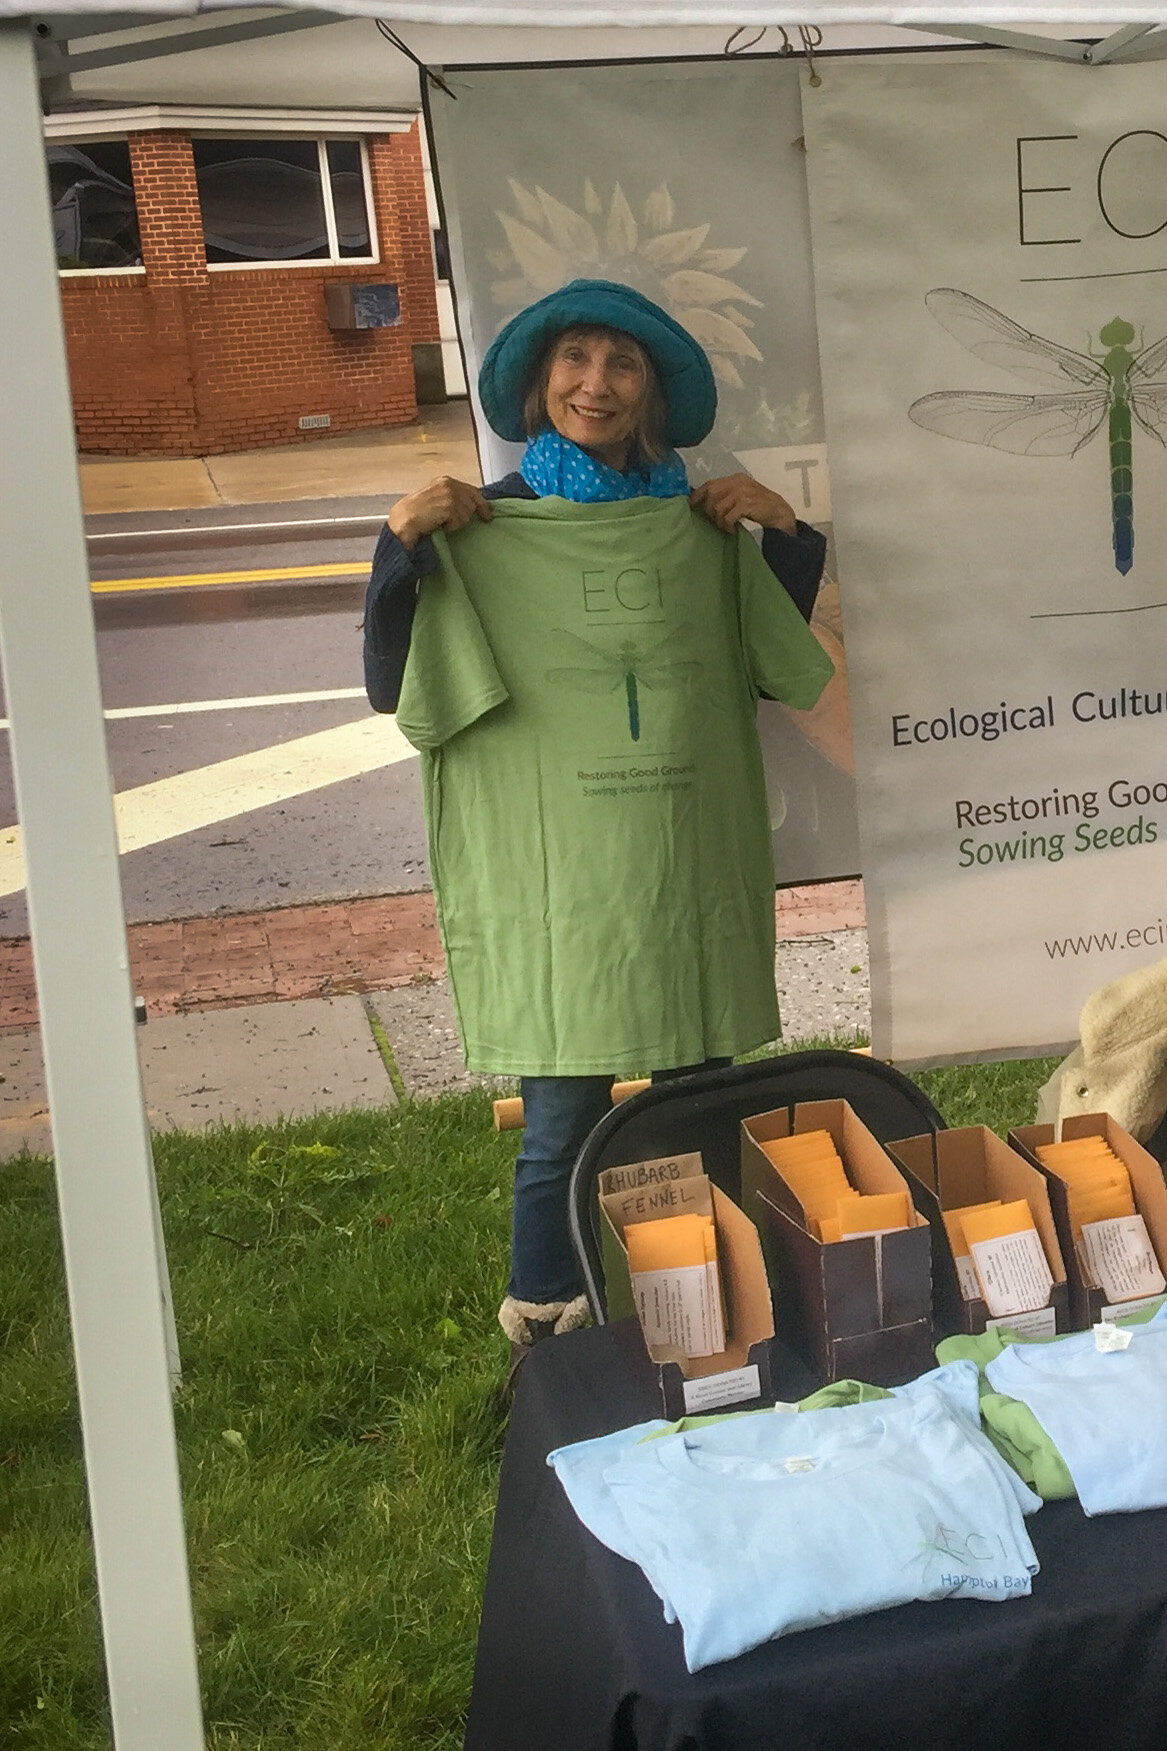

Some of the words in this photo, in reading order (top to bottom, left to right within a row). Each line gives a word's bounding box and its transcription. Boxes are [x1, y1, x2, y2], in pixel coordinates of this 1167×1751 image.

[583, 568, 664, 612] ECI
[891, 695, 1055, 747] Ecological
[577, 769, 627, 781] Restoring
[629, 765, 659, 778] Good
[954, 788, 1100, 829] Restoring
[957, 830, 1066, 868] Sowing
[1074, 815, 1158, 853] Seeds
[605, 1161, 681, 1194] RHUBARB
[620, 1187, 696, 1217] FENNEL
